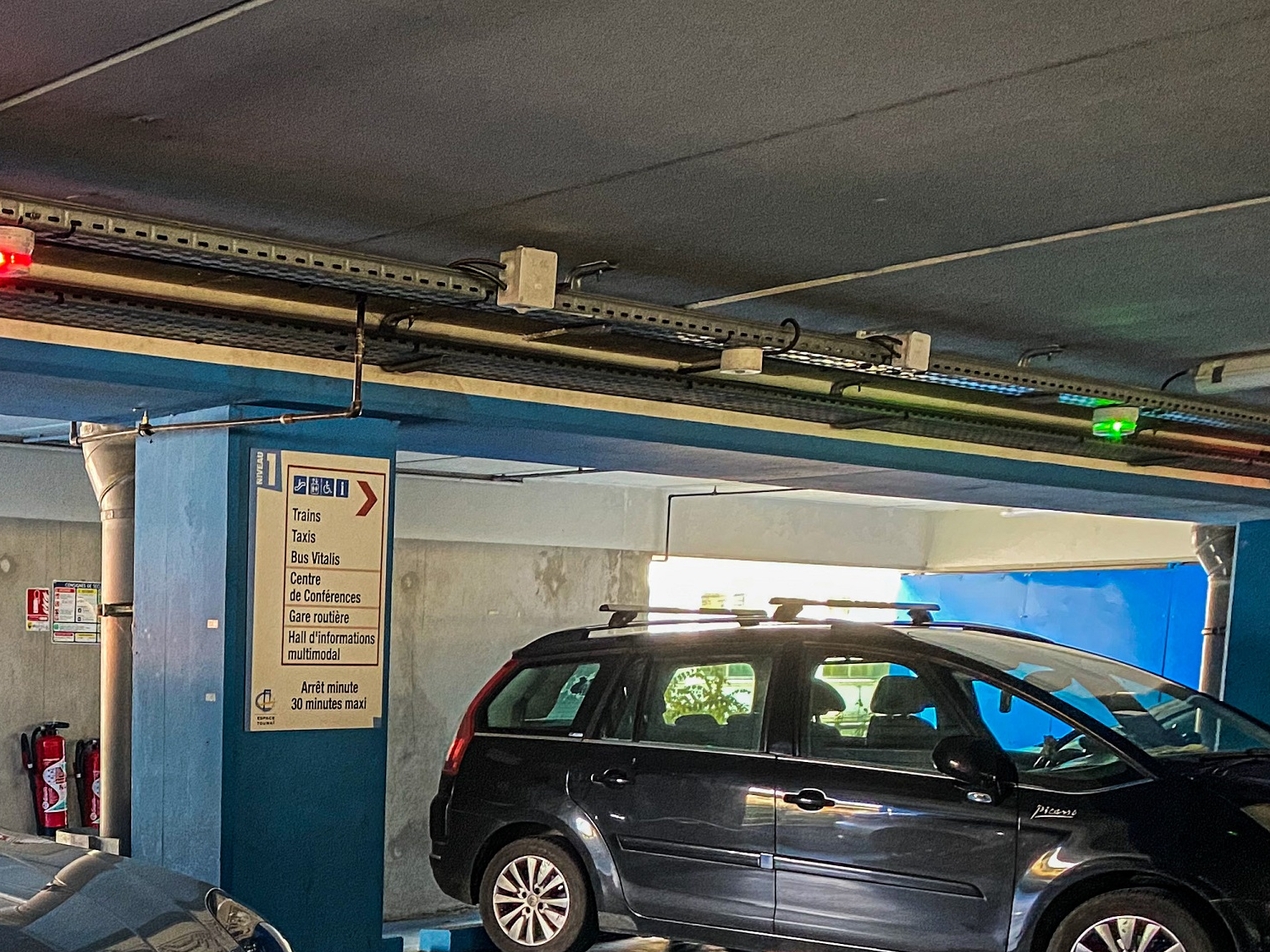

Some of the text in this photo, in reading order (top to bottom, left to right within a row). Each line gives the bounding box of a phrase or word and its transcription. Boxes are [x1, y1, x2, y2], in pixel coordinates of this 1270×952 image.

[256, 451, 264, 485] NIVEAU
[267, 453, 277, 486] 1
[292, 508, 321, 523] Trains
[292, 529, 316, 543] Taxis
[291, 551, 340, 566] Bus Vitalis
[290, 572, 321, 586] Centre
[290, 589, 361, 604] de Conférences
[289, 610, 350, 624] Gare routière
[288, 630, 375, 645] Hall d'informations
[288, 648, 340, 661] multimodal
[301, 681, 359, 694] Arrêt minute
[291, 697, 367, 710] 30 minutes maxi
